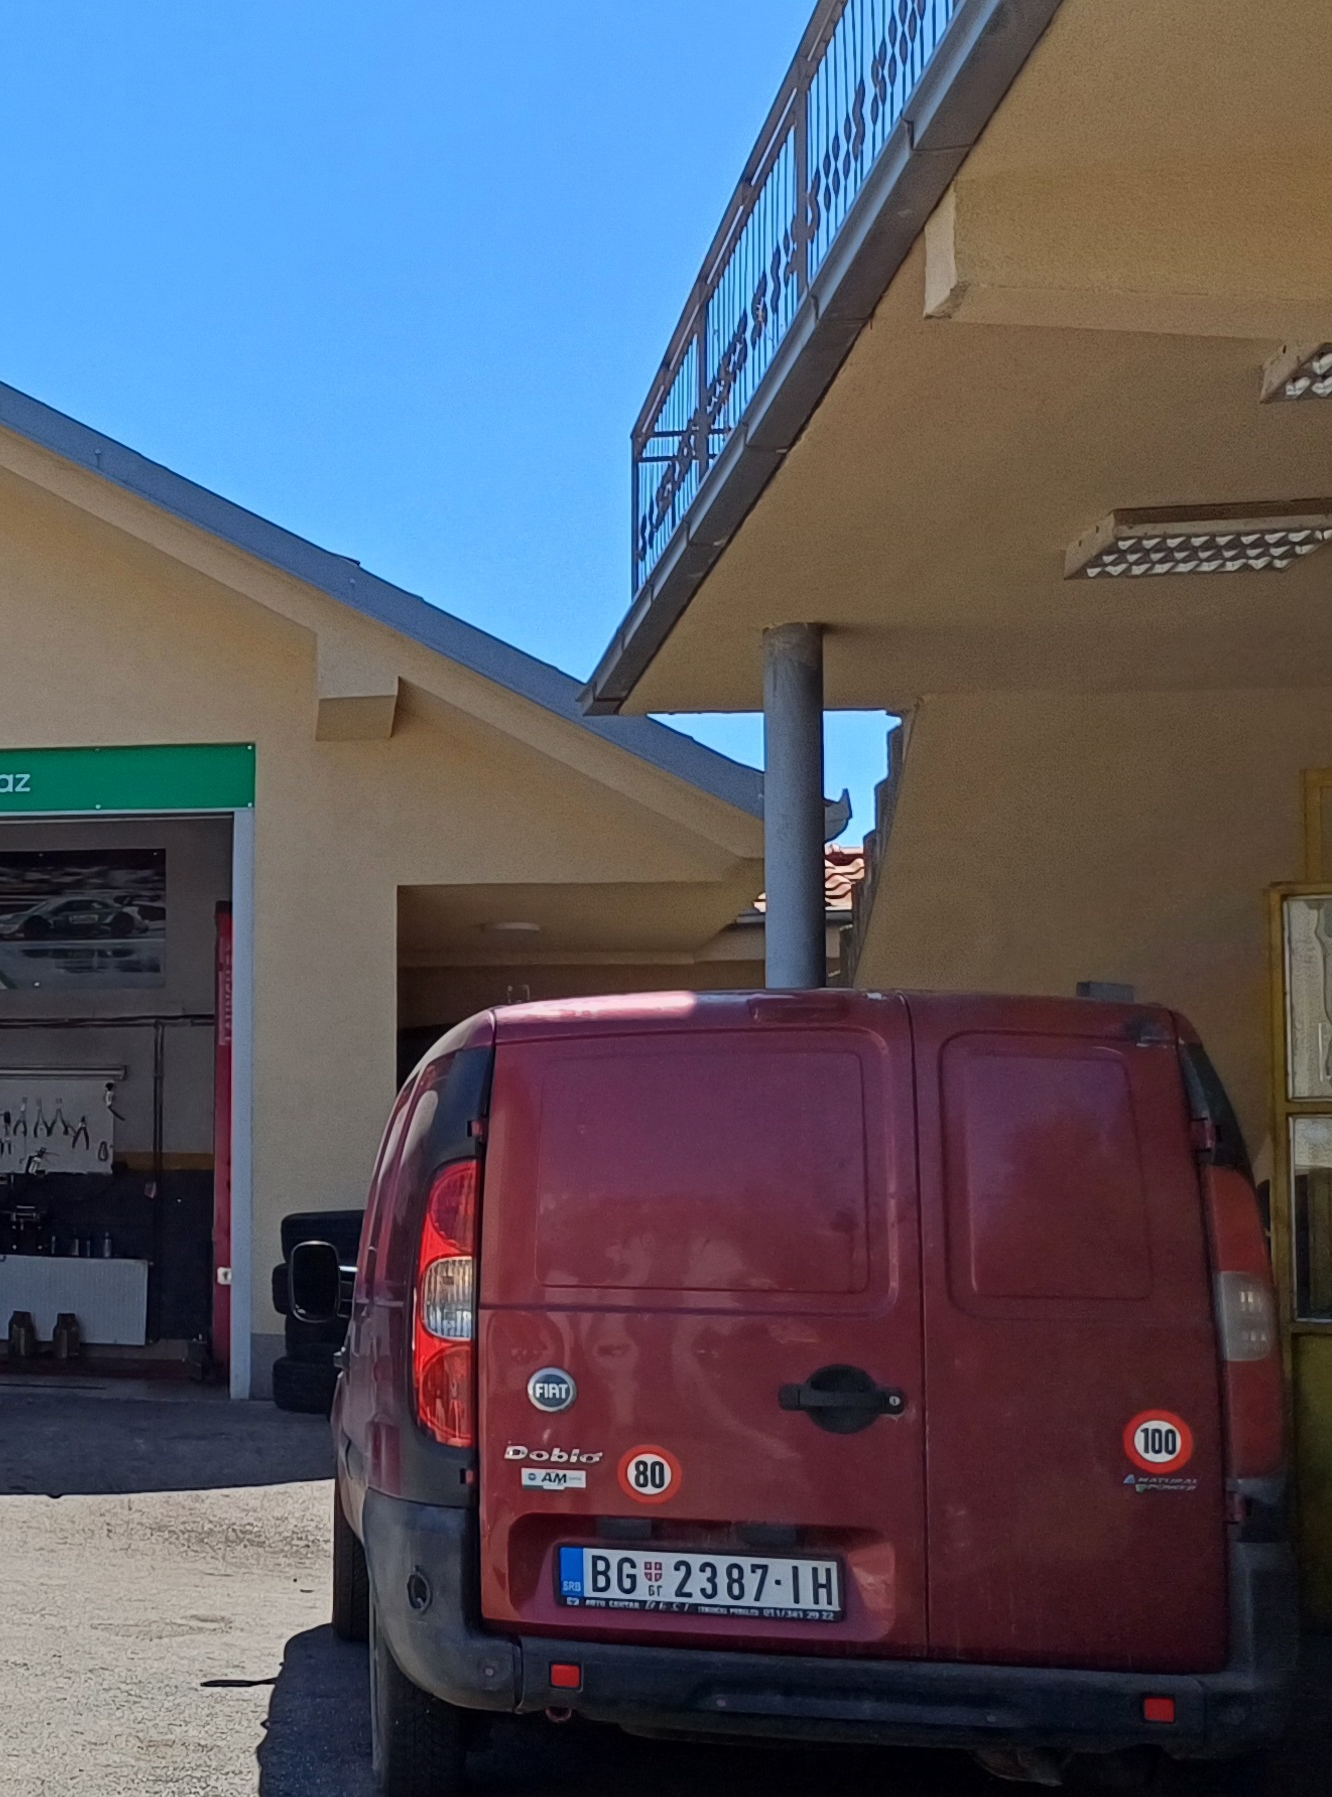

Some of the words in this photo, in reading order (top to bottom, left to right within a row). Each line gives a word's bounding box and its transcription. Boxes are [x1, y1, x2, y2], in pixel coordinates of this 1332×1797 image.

[535, 1383, 569, 1400] FIAT
[1140, 1427, 1177, 1456] 100
[634, 1460, 666, 1489] 80
[562, 1580, 582, 1592] SRB
[591, 1554, 637, 1595] BG
